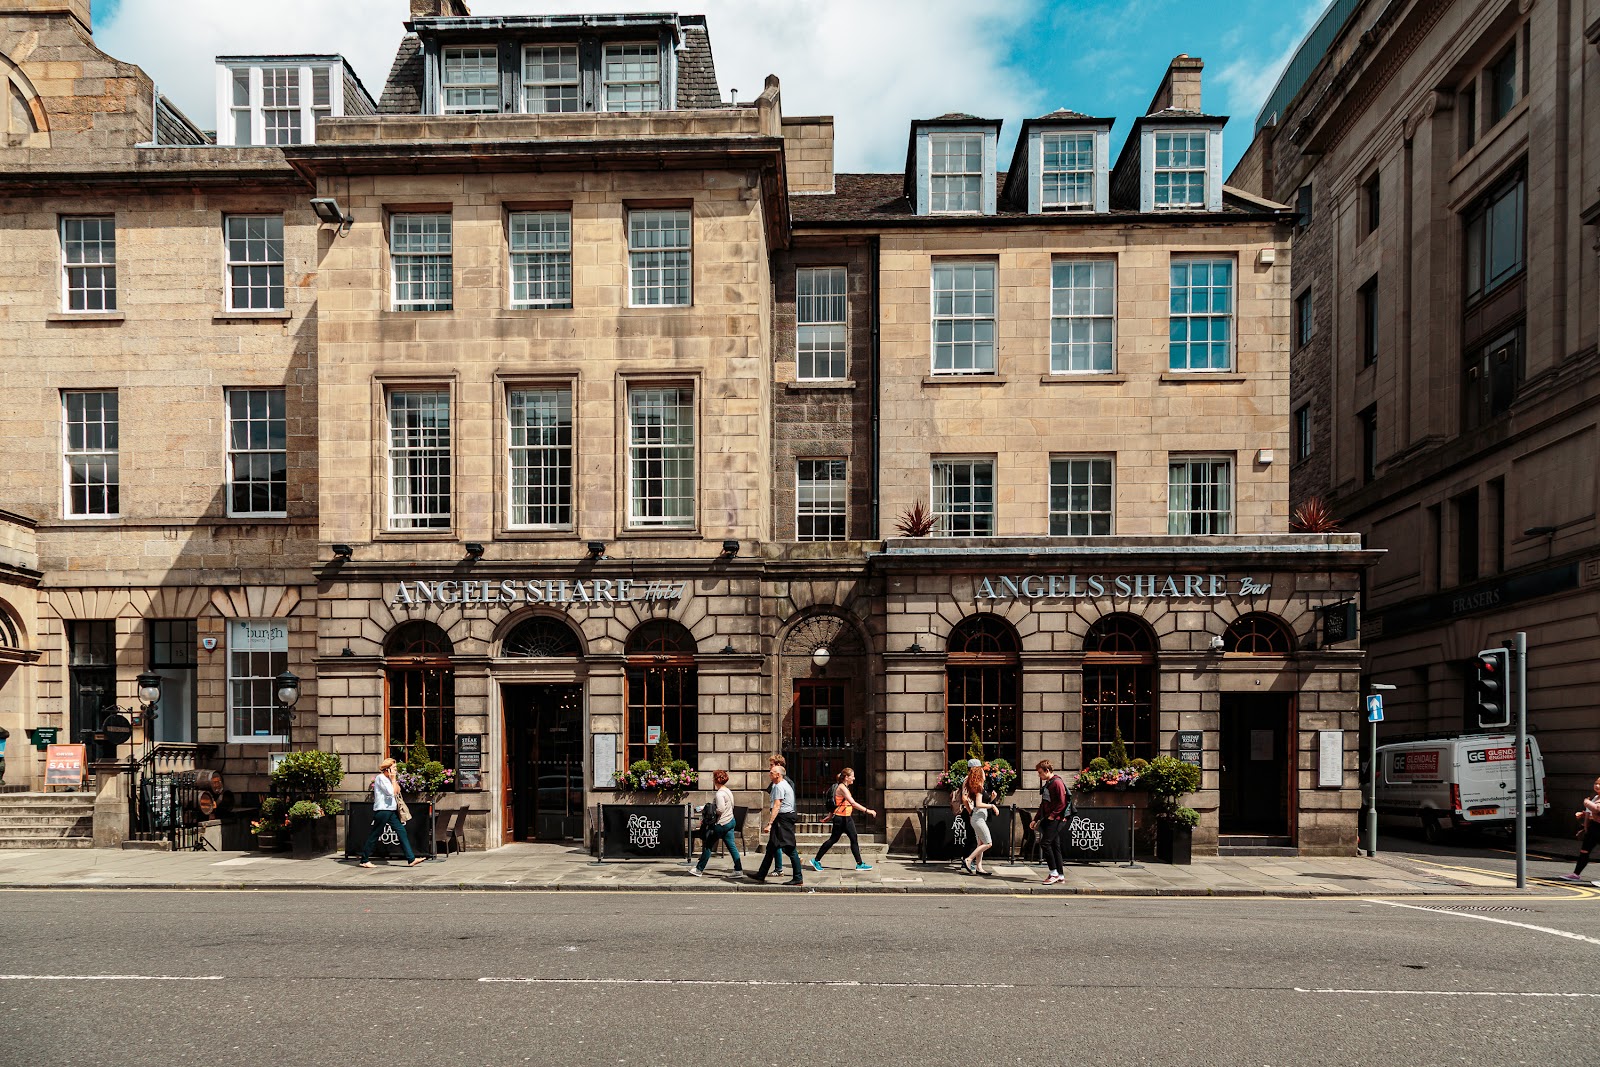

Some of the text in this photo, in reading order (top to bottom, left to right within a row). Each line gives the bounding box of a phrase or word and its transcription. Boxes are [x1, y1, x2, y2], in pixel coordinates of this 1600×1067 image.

[391, 578, 687, 603] ANGELS SHARE Hotel
[974, 574, 1271, 598] ANGELS SHARE Bar
[1452, 588, 1500, 613] FRASERS
[1394, 754, 1437, 770] GE GLENDALE
[1468, 751, 1486, 761] GE
[626, 814, 661, 828] ANGELS
[1068, 816, 1105, 830] ANGELS
[630, 828, 658, 837] SHARE
[1072, 830, 1102, 839] SHARE
[630, 836, 660, 848] HOTEL
[1072, 838, 1104, 850] HOTEL
